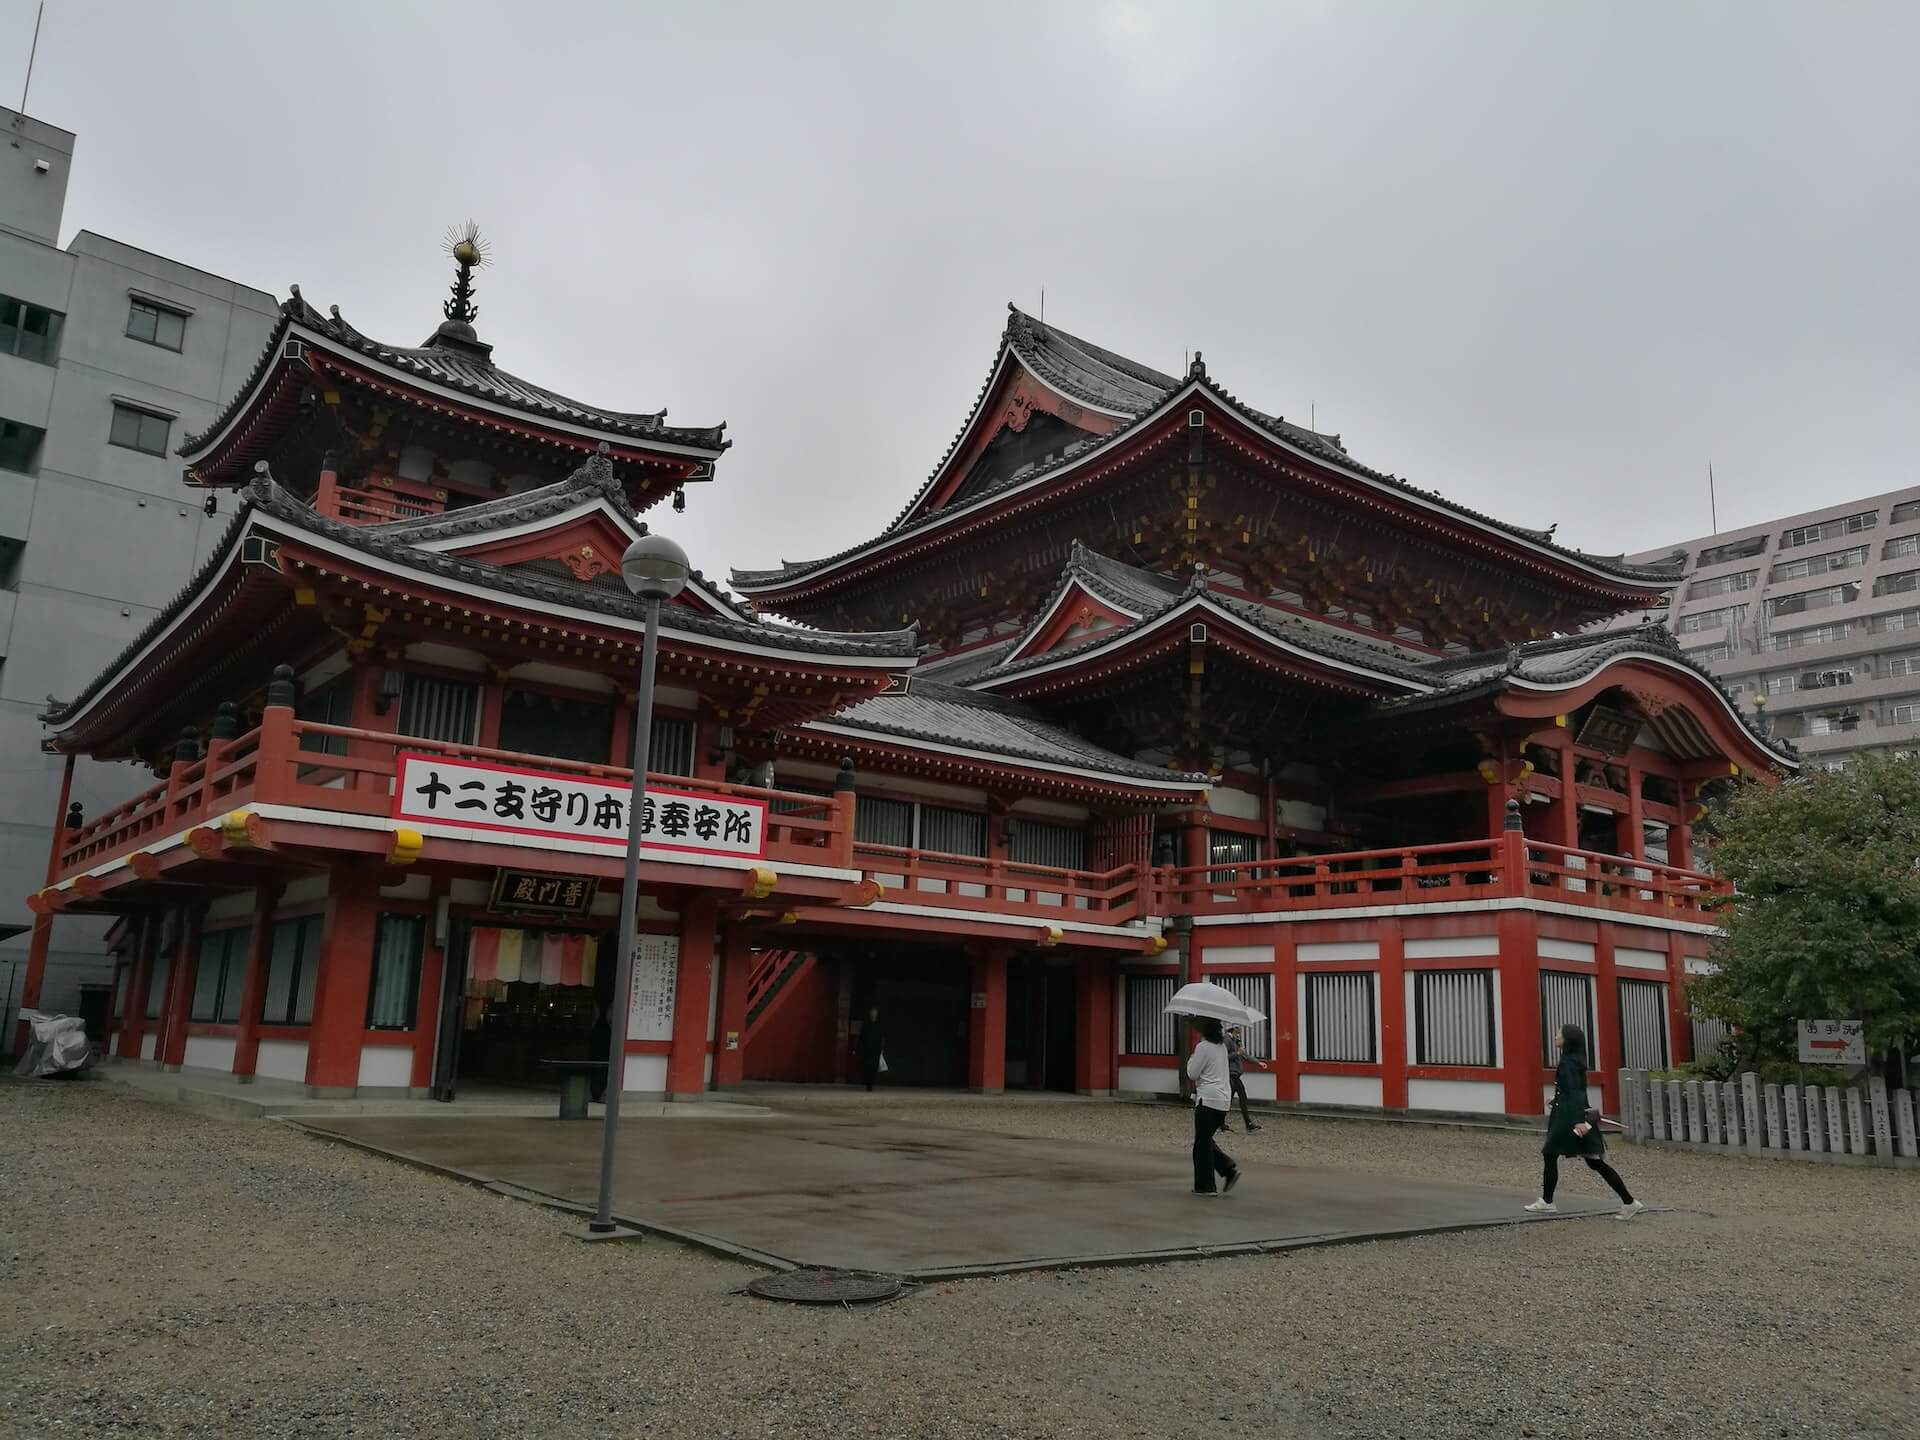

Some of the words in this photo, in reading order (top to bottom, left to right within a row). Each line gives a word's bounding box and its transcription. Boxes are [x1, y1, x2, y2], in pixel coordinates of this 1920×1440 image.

[415, 771, 752, 845] 十二支守り本尊奉安所
